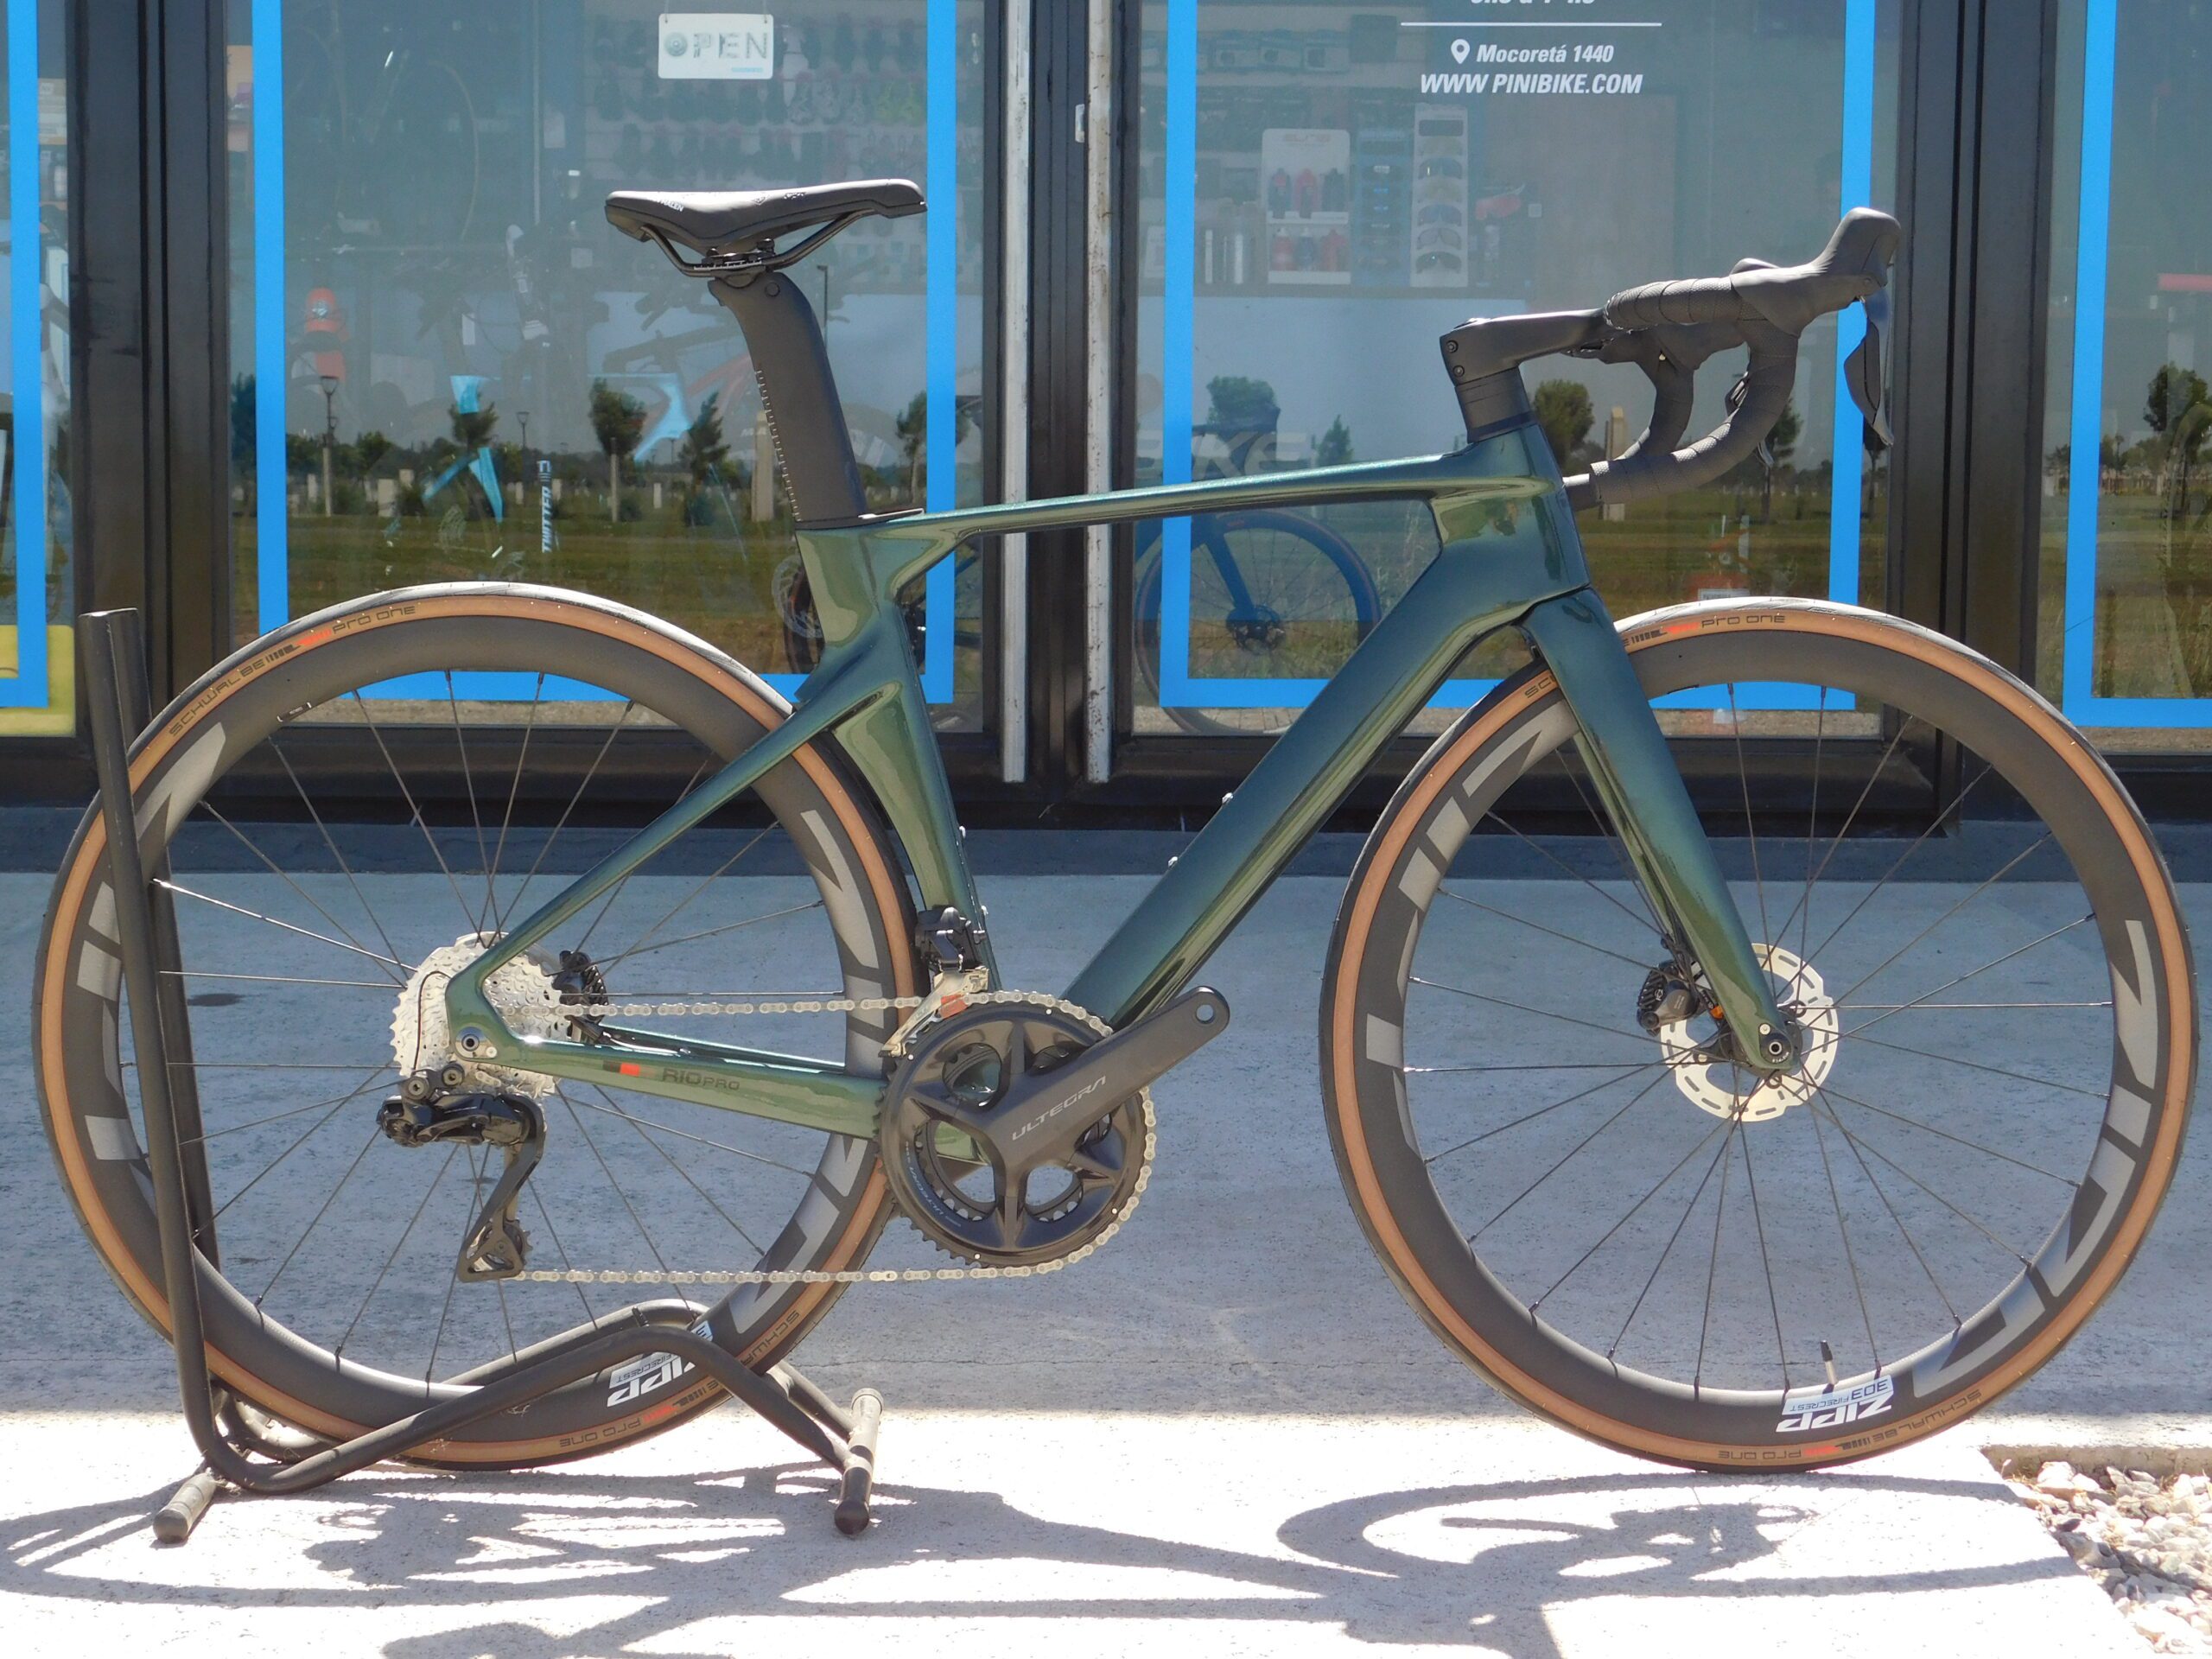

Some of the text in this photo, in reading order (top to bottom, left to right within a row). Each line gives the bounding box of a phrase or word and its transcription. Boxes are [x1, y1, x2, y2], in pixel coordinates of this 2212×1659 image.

[664, 32, 767, 59] OPEN
[1477, 44, 1614, 62] Mocoretá 1440
[541, 486, 553, 554] TWITTER
[168, 659, 264, 736] SCHWALBE
[1012, 1075, 1106, 1141] ULTEGRA
[607, 1356, 696, 1408] IPP
[1789, 1378, 1889, 1412] 303 FIRECREST
[1775, 1390, 1895, 1433] ZIPP
[1873, 1388, 1985, 1443] SCHWALBE
